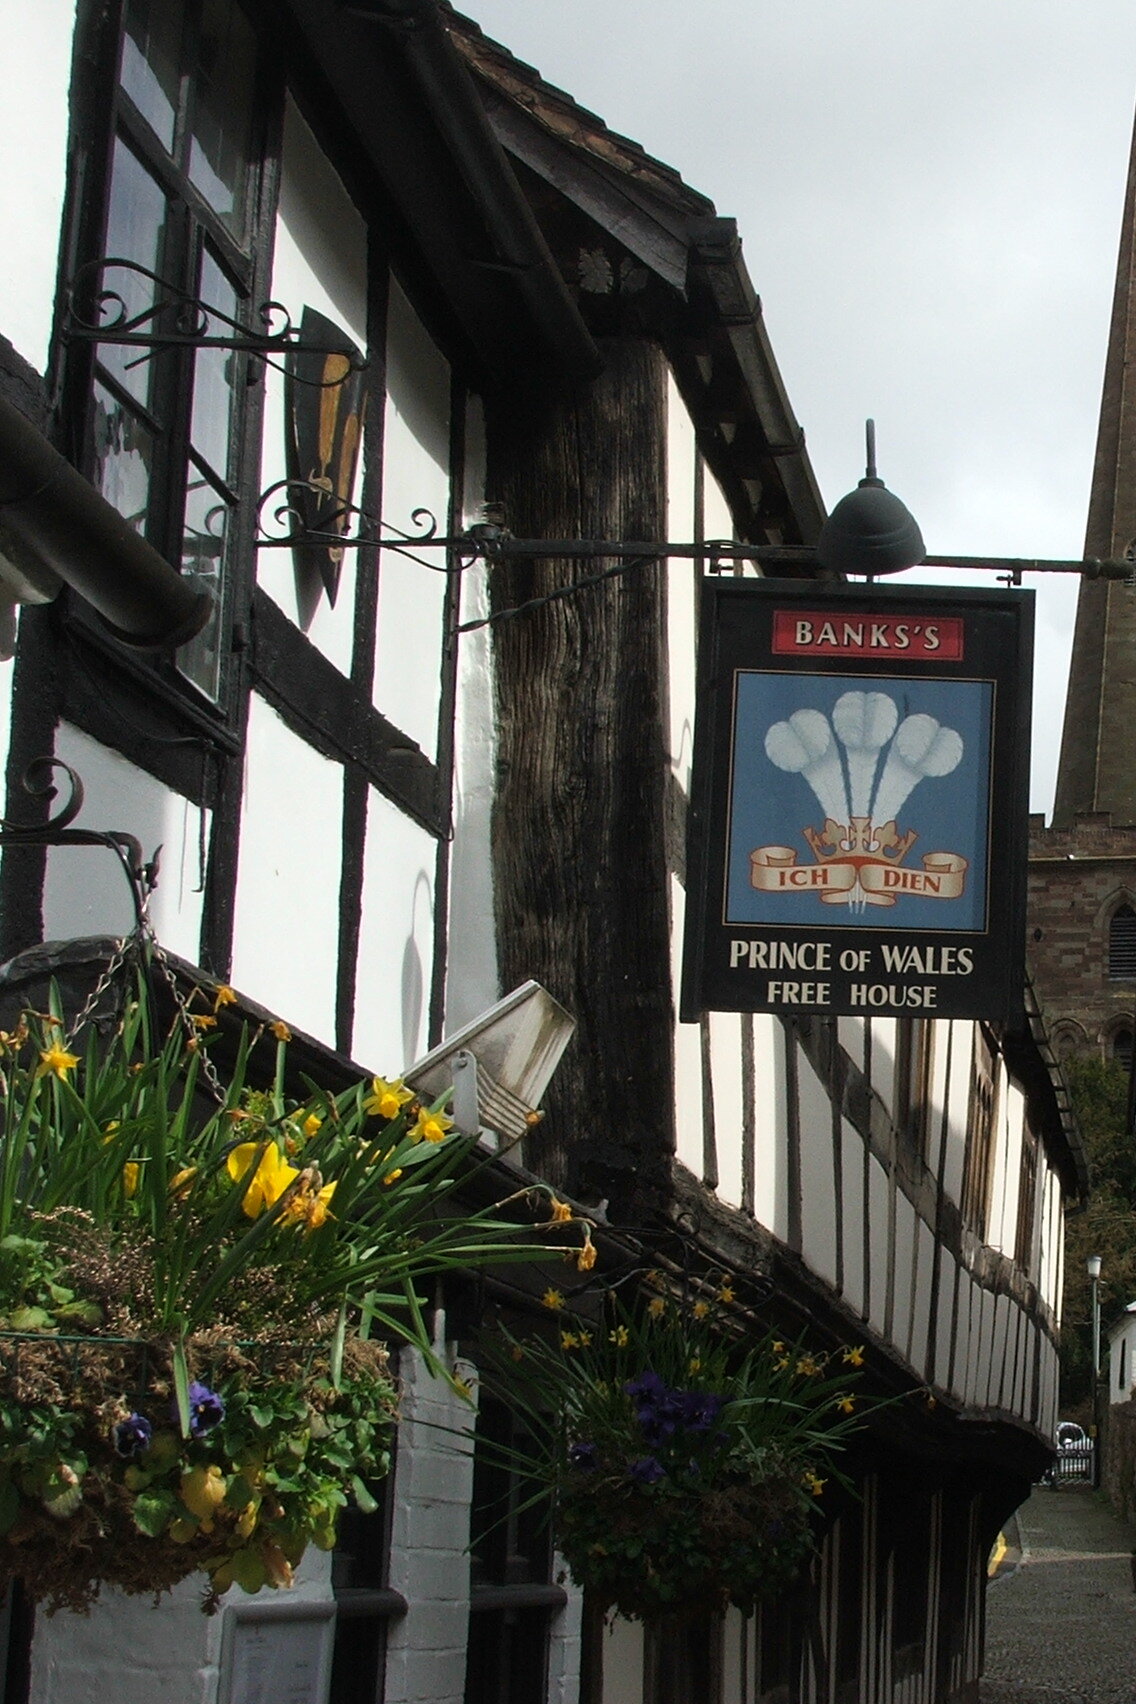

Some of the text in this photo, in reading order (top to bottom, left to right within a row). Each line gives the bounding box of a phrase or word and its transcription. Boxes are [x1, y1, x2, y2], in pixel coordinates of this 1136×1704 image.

[778, 869, 942, 893] ICH DIEN
[729, 940, 832, 971] PRINCE
[881, 944, 974, 975] WALES
[767, 981, 937, 1008] FREE HOUSE
